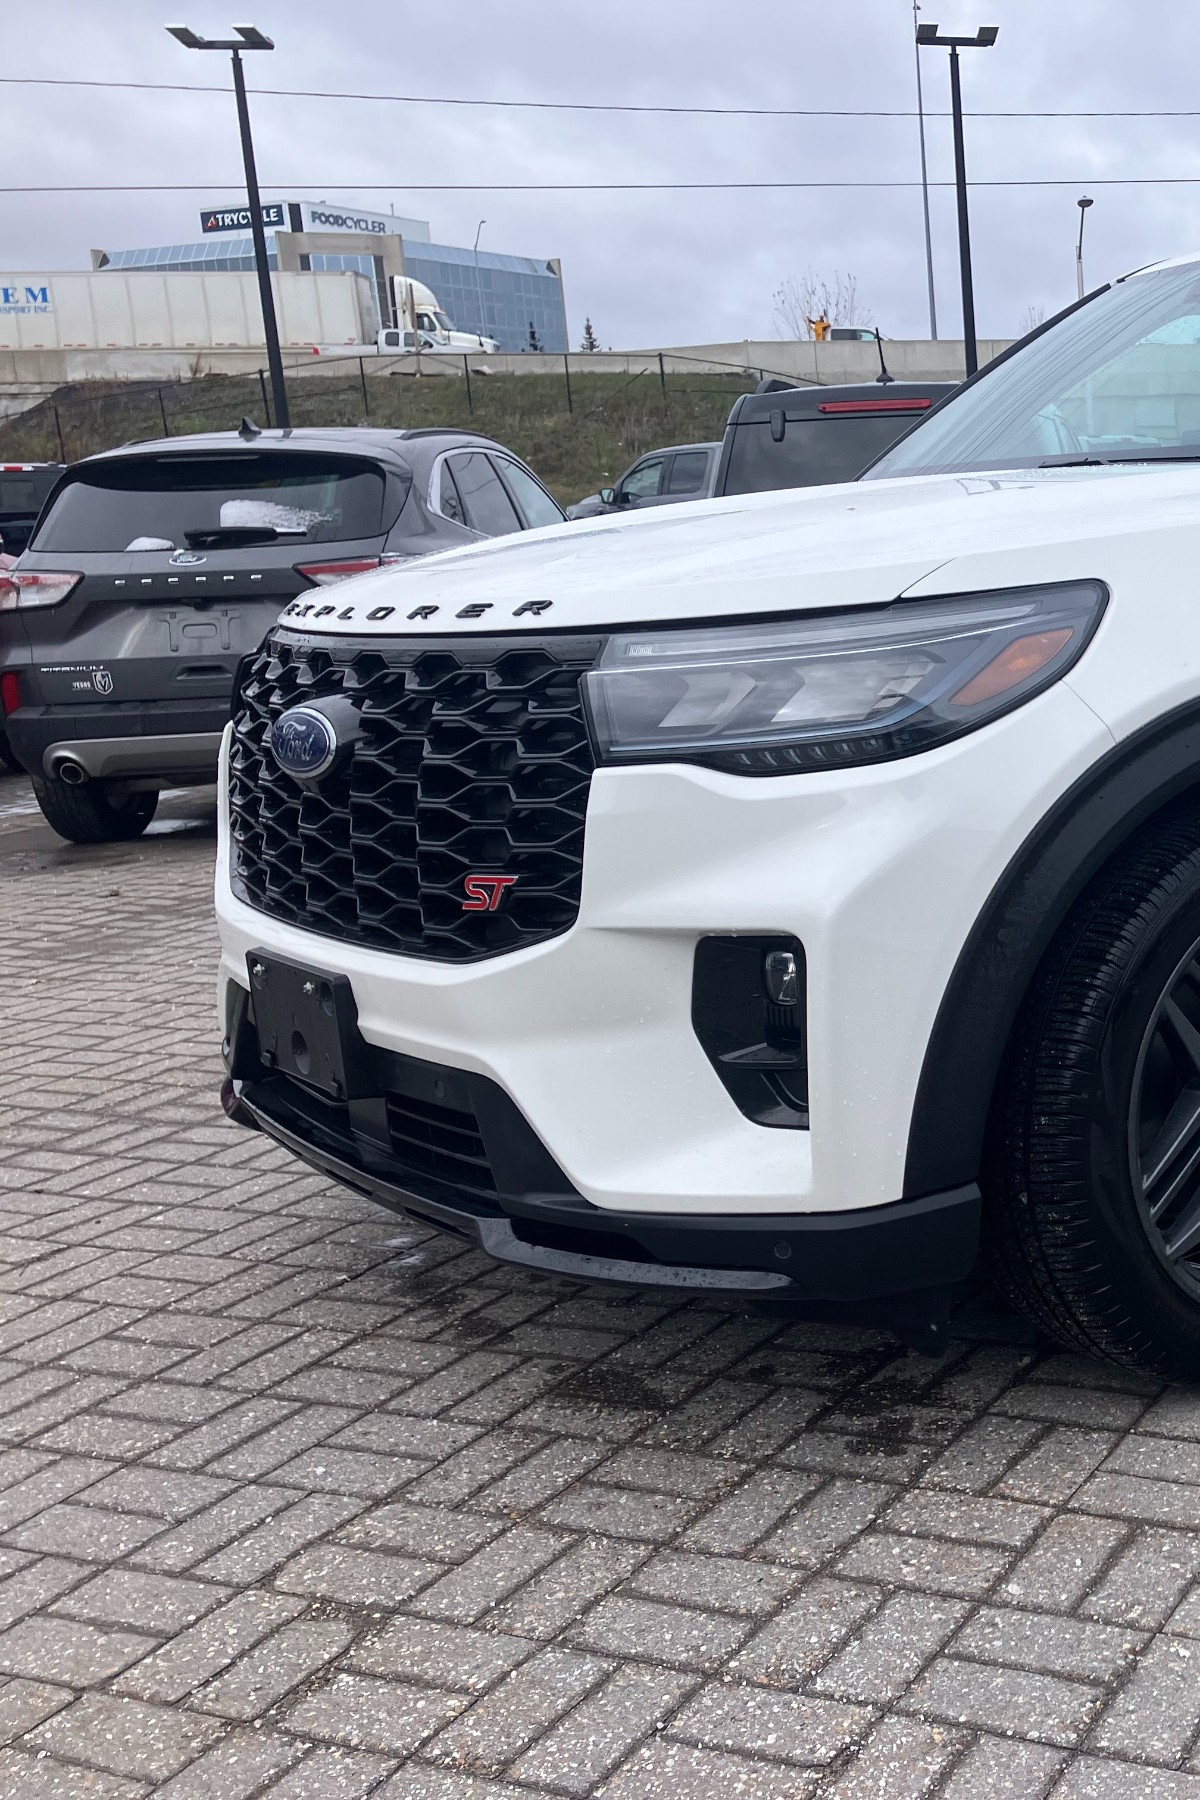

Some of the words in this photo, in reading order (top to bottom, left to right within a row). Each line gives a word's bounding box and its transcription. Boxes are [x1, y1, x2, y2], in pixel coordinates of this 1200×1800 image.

[216, 208, 279, 226] TRYCLE
[310, 211, 387, 234] FOODCYCLER
[284, 599, 554, 621] EXPLORER
[278, 721, 315, 761] Ford
[462, 874, 519, 911] ST
